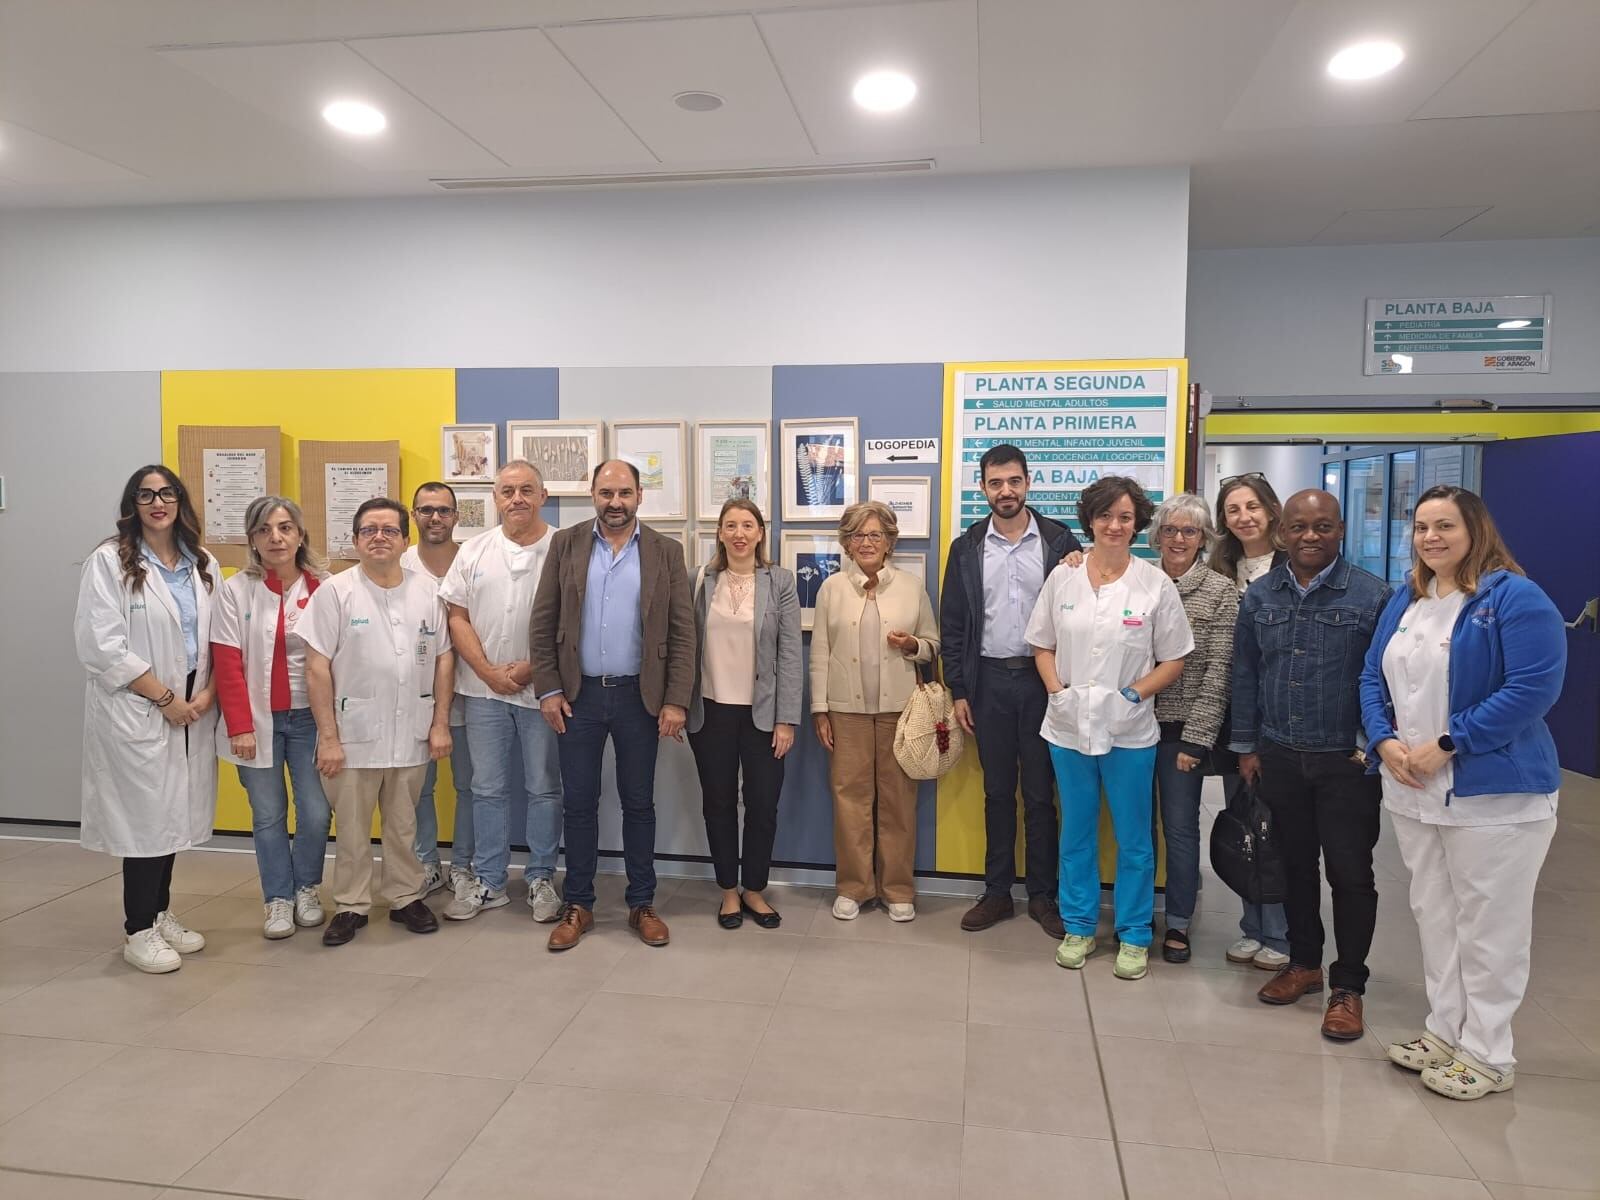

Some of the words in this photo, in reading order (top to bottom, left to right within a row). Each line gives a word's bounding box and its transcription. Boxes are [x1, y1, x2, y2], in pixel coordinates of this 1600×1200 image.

[1385, 303, 1447, 315] PLANTA
[1452, 301, 1494, 314] BAJA
[1398, 332, 1438, 340] MEDICINA
[975, 376, 1048, 392] PLANTA
[1054, 375, 1146, 391] SEGUNDA
[992, 399, 1023, 409] SALUD
[1025, 399, 1062, 408] MENTAL
[1065, 398, 1109, 407] ADULTOS
[974, 416, 1047, 431] PLANTA
[1052, 415, 1137, 430] PRIMERA
[867, 439, 936, 450] LOGOPEDIA
[1024, 439, 1060, 447] MENTAL
[1063, 438, 1105, 447] INFANTO
[1106, 438, 1145, 447] JUVENIL
[1043, 453, 1049, 461] Y
[1052, 452, 1099, 461] DOCENCIA
[1051, 469, 1099, 484] BAJA
[1047, 505, 1058, 514] LA
